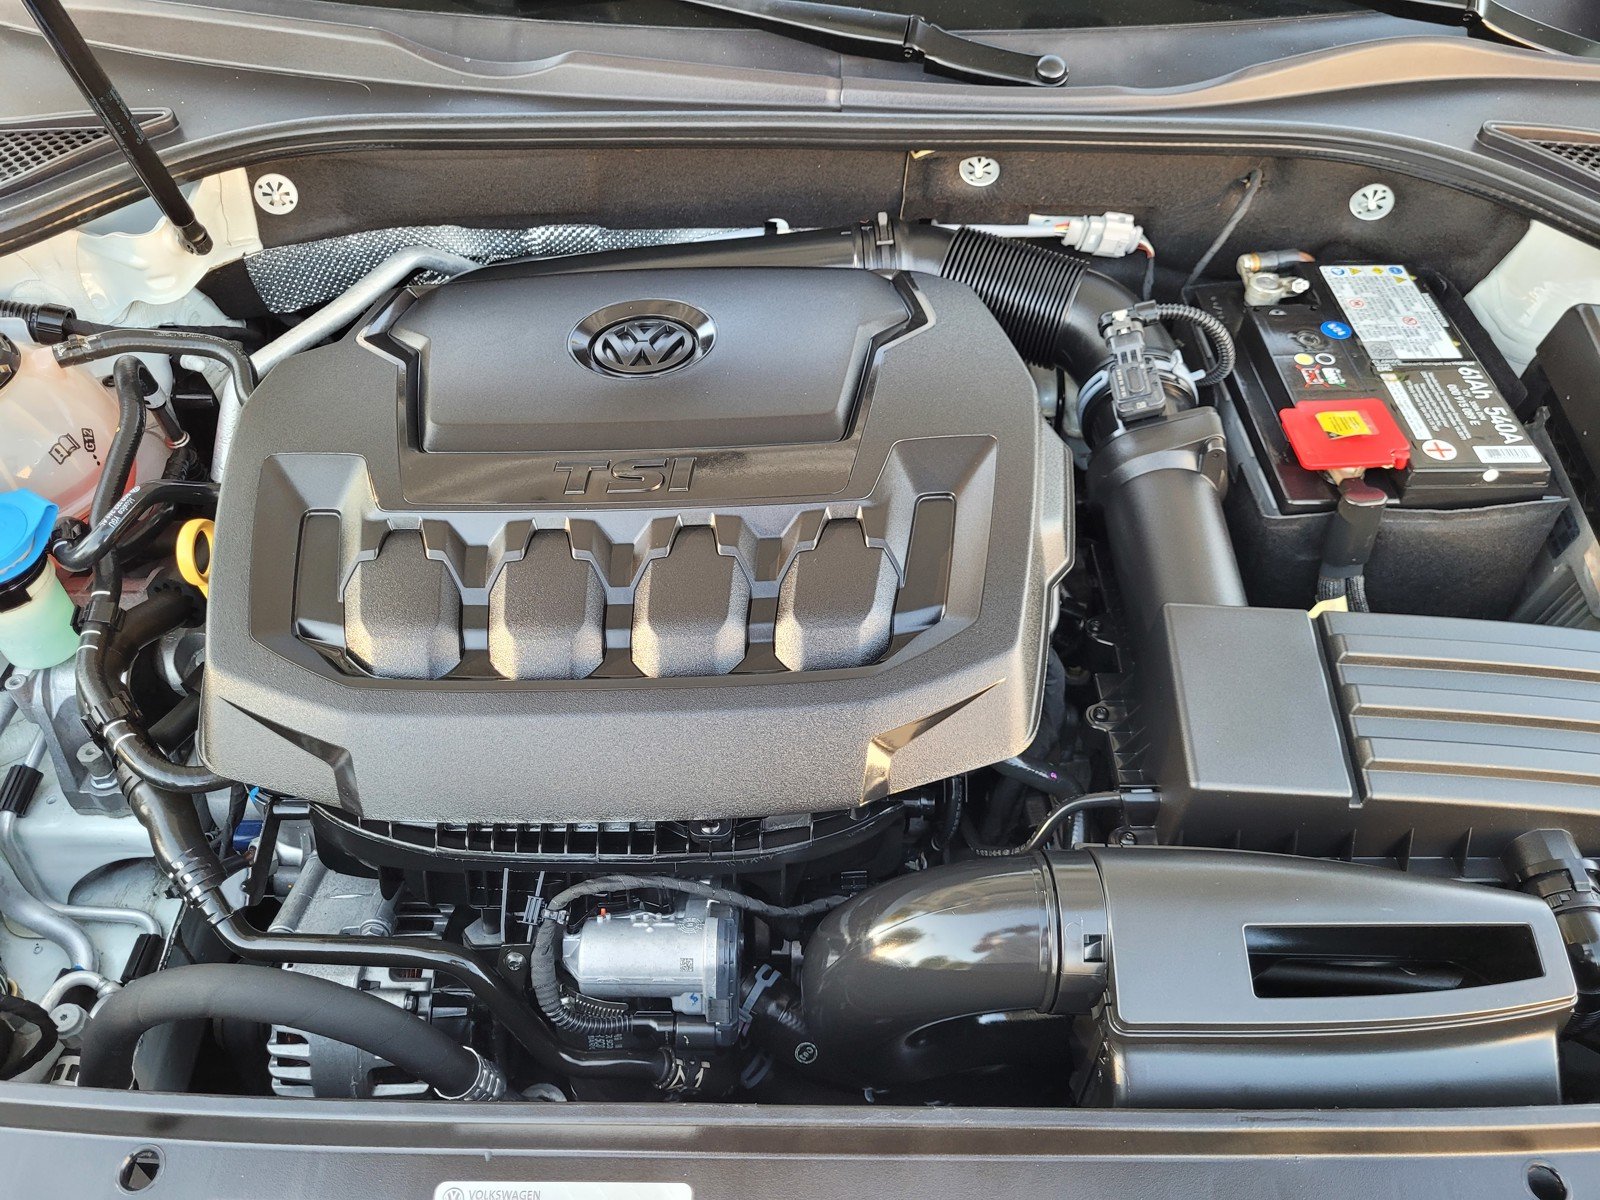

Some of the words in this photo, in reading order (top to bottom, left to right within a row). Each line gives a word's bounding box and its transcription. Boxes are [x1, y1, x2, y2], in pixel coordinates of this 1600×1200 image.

[1457, 366, 1494, 399] 61Ah
[1483, 406, 1524, 445] 540A
[83, 428, 95, 452] G12
[554, 457, 697, 495] TSI
[468, 1189, 541, 1200] VOLKSWAGEN
